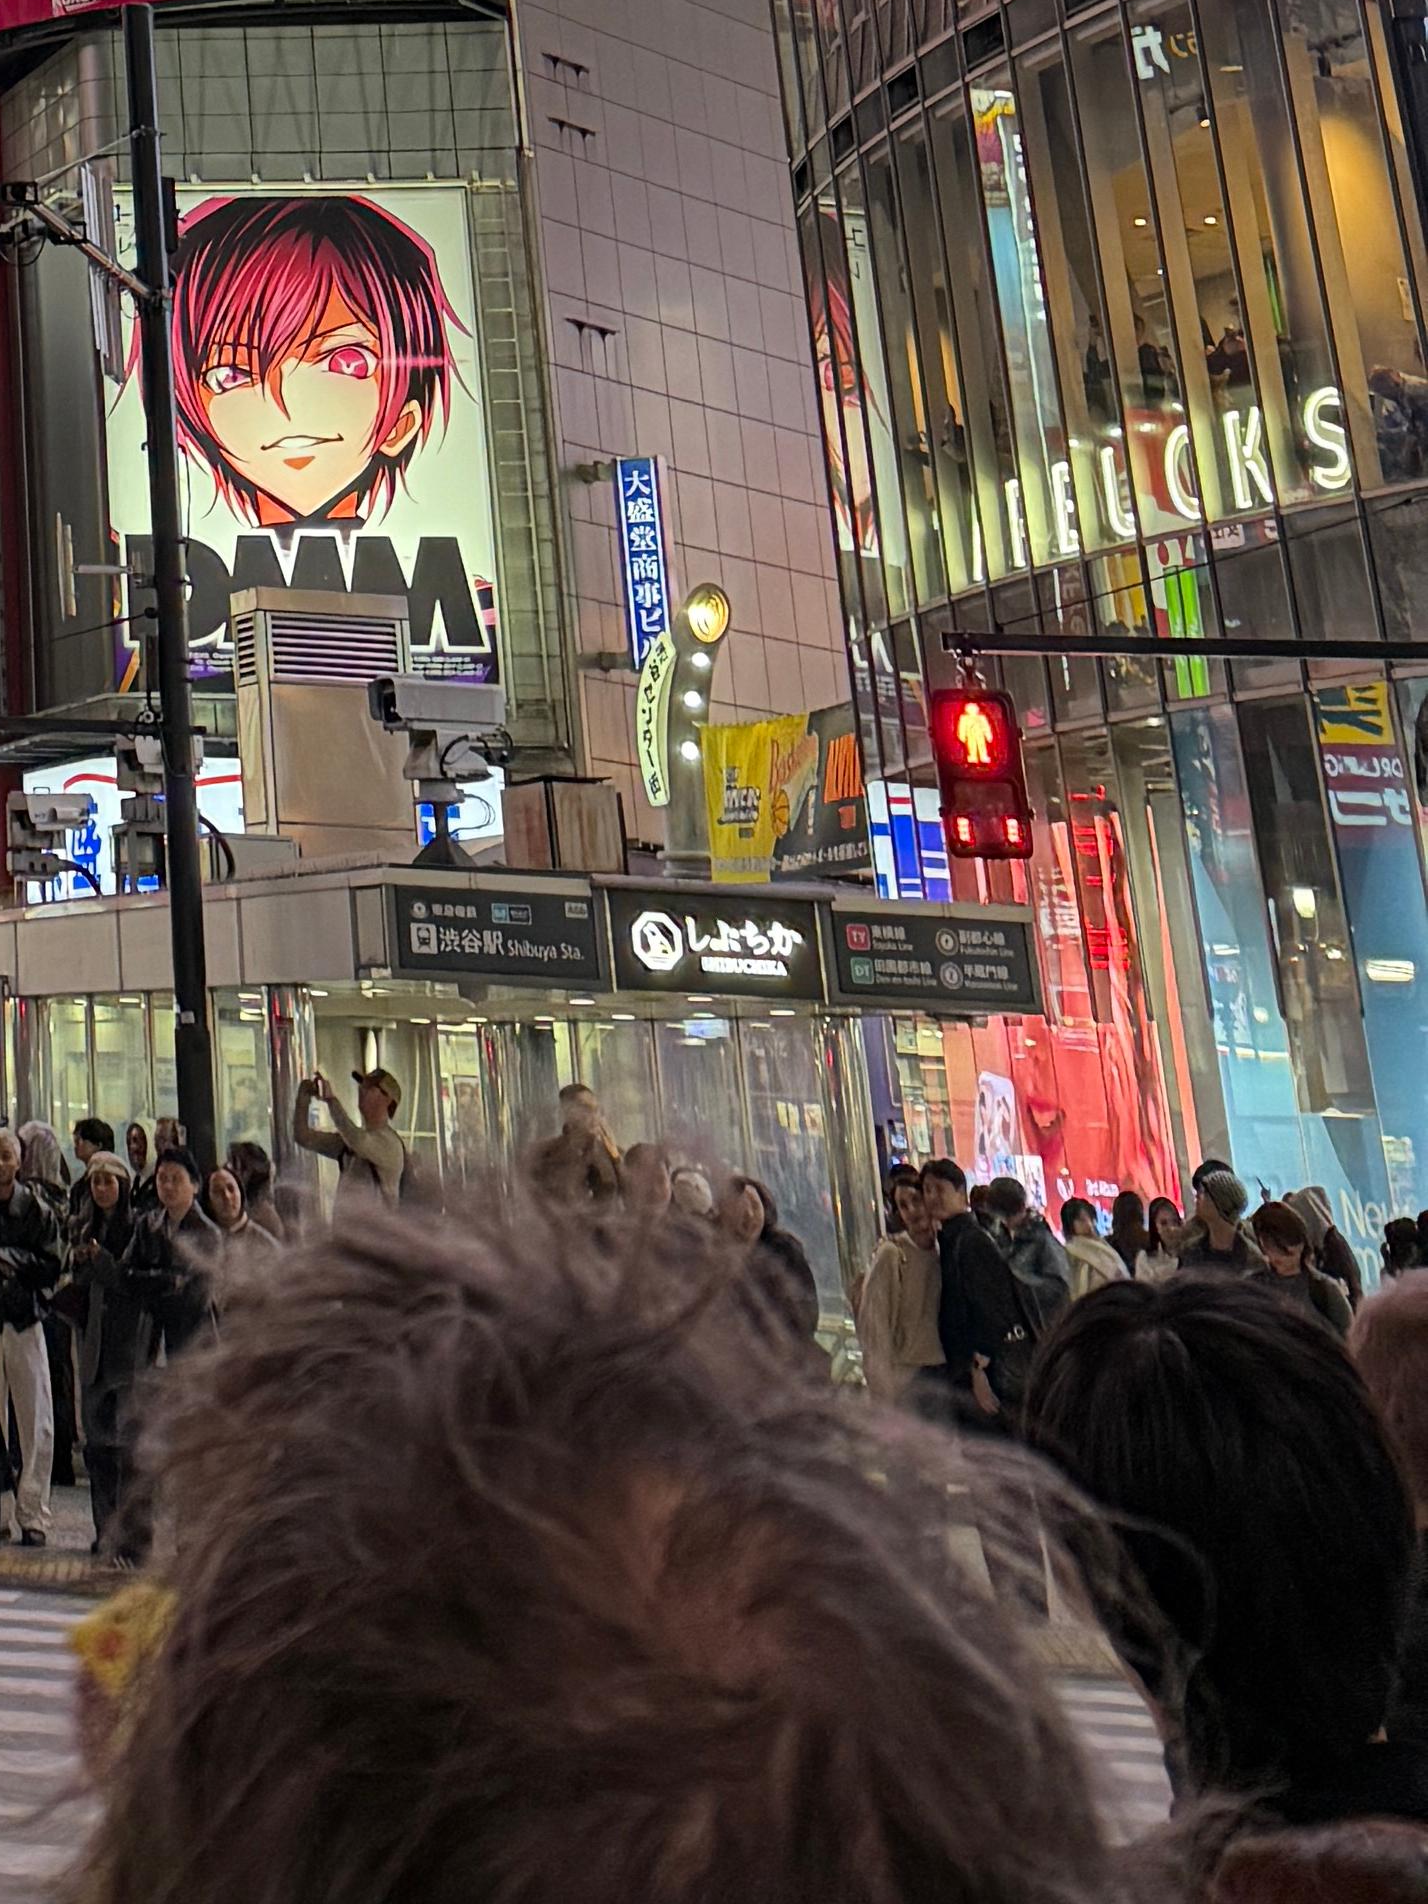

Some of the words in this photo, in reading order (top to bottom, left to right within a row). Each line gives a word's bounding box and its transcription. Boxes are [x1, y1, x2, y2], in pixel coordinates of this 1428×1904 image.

[124, 533, 486, 649] DMM
[439, 926, 505, 957] 渋谷駅
[507, 940, 558, 963] Shibuya
